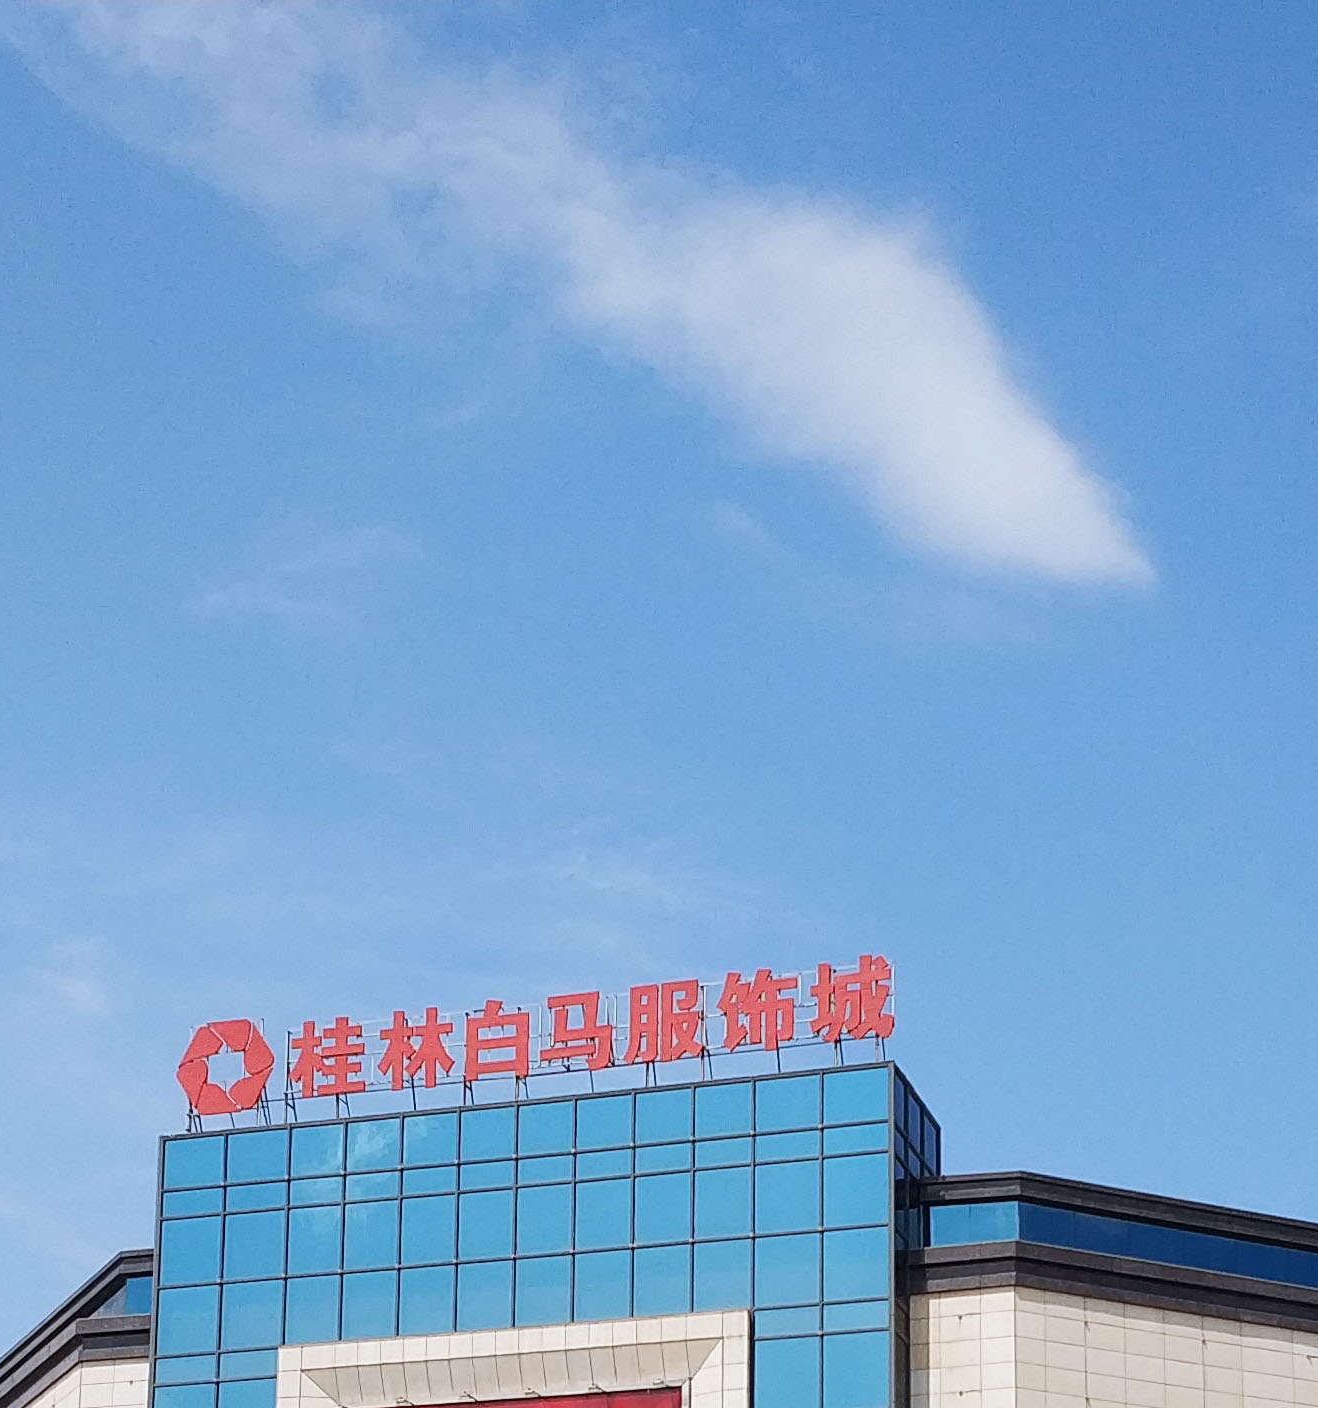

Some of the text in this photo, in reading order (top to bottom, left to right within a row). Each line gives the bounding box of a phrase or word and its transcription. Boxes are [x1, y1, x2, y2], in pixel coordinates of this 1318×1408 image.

[288, 955, 895, 1098] 桂林白马服饰城
